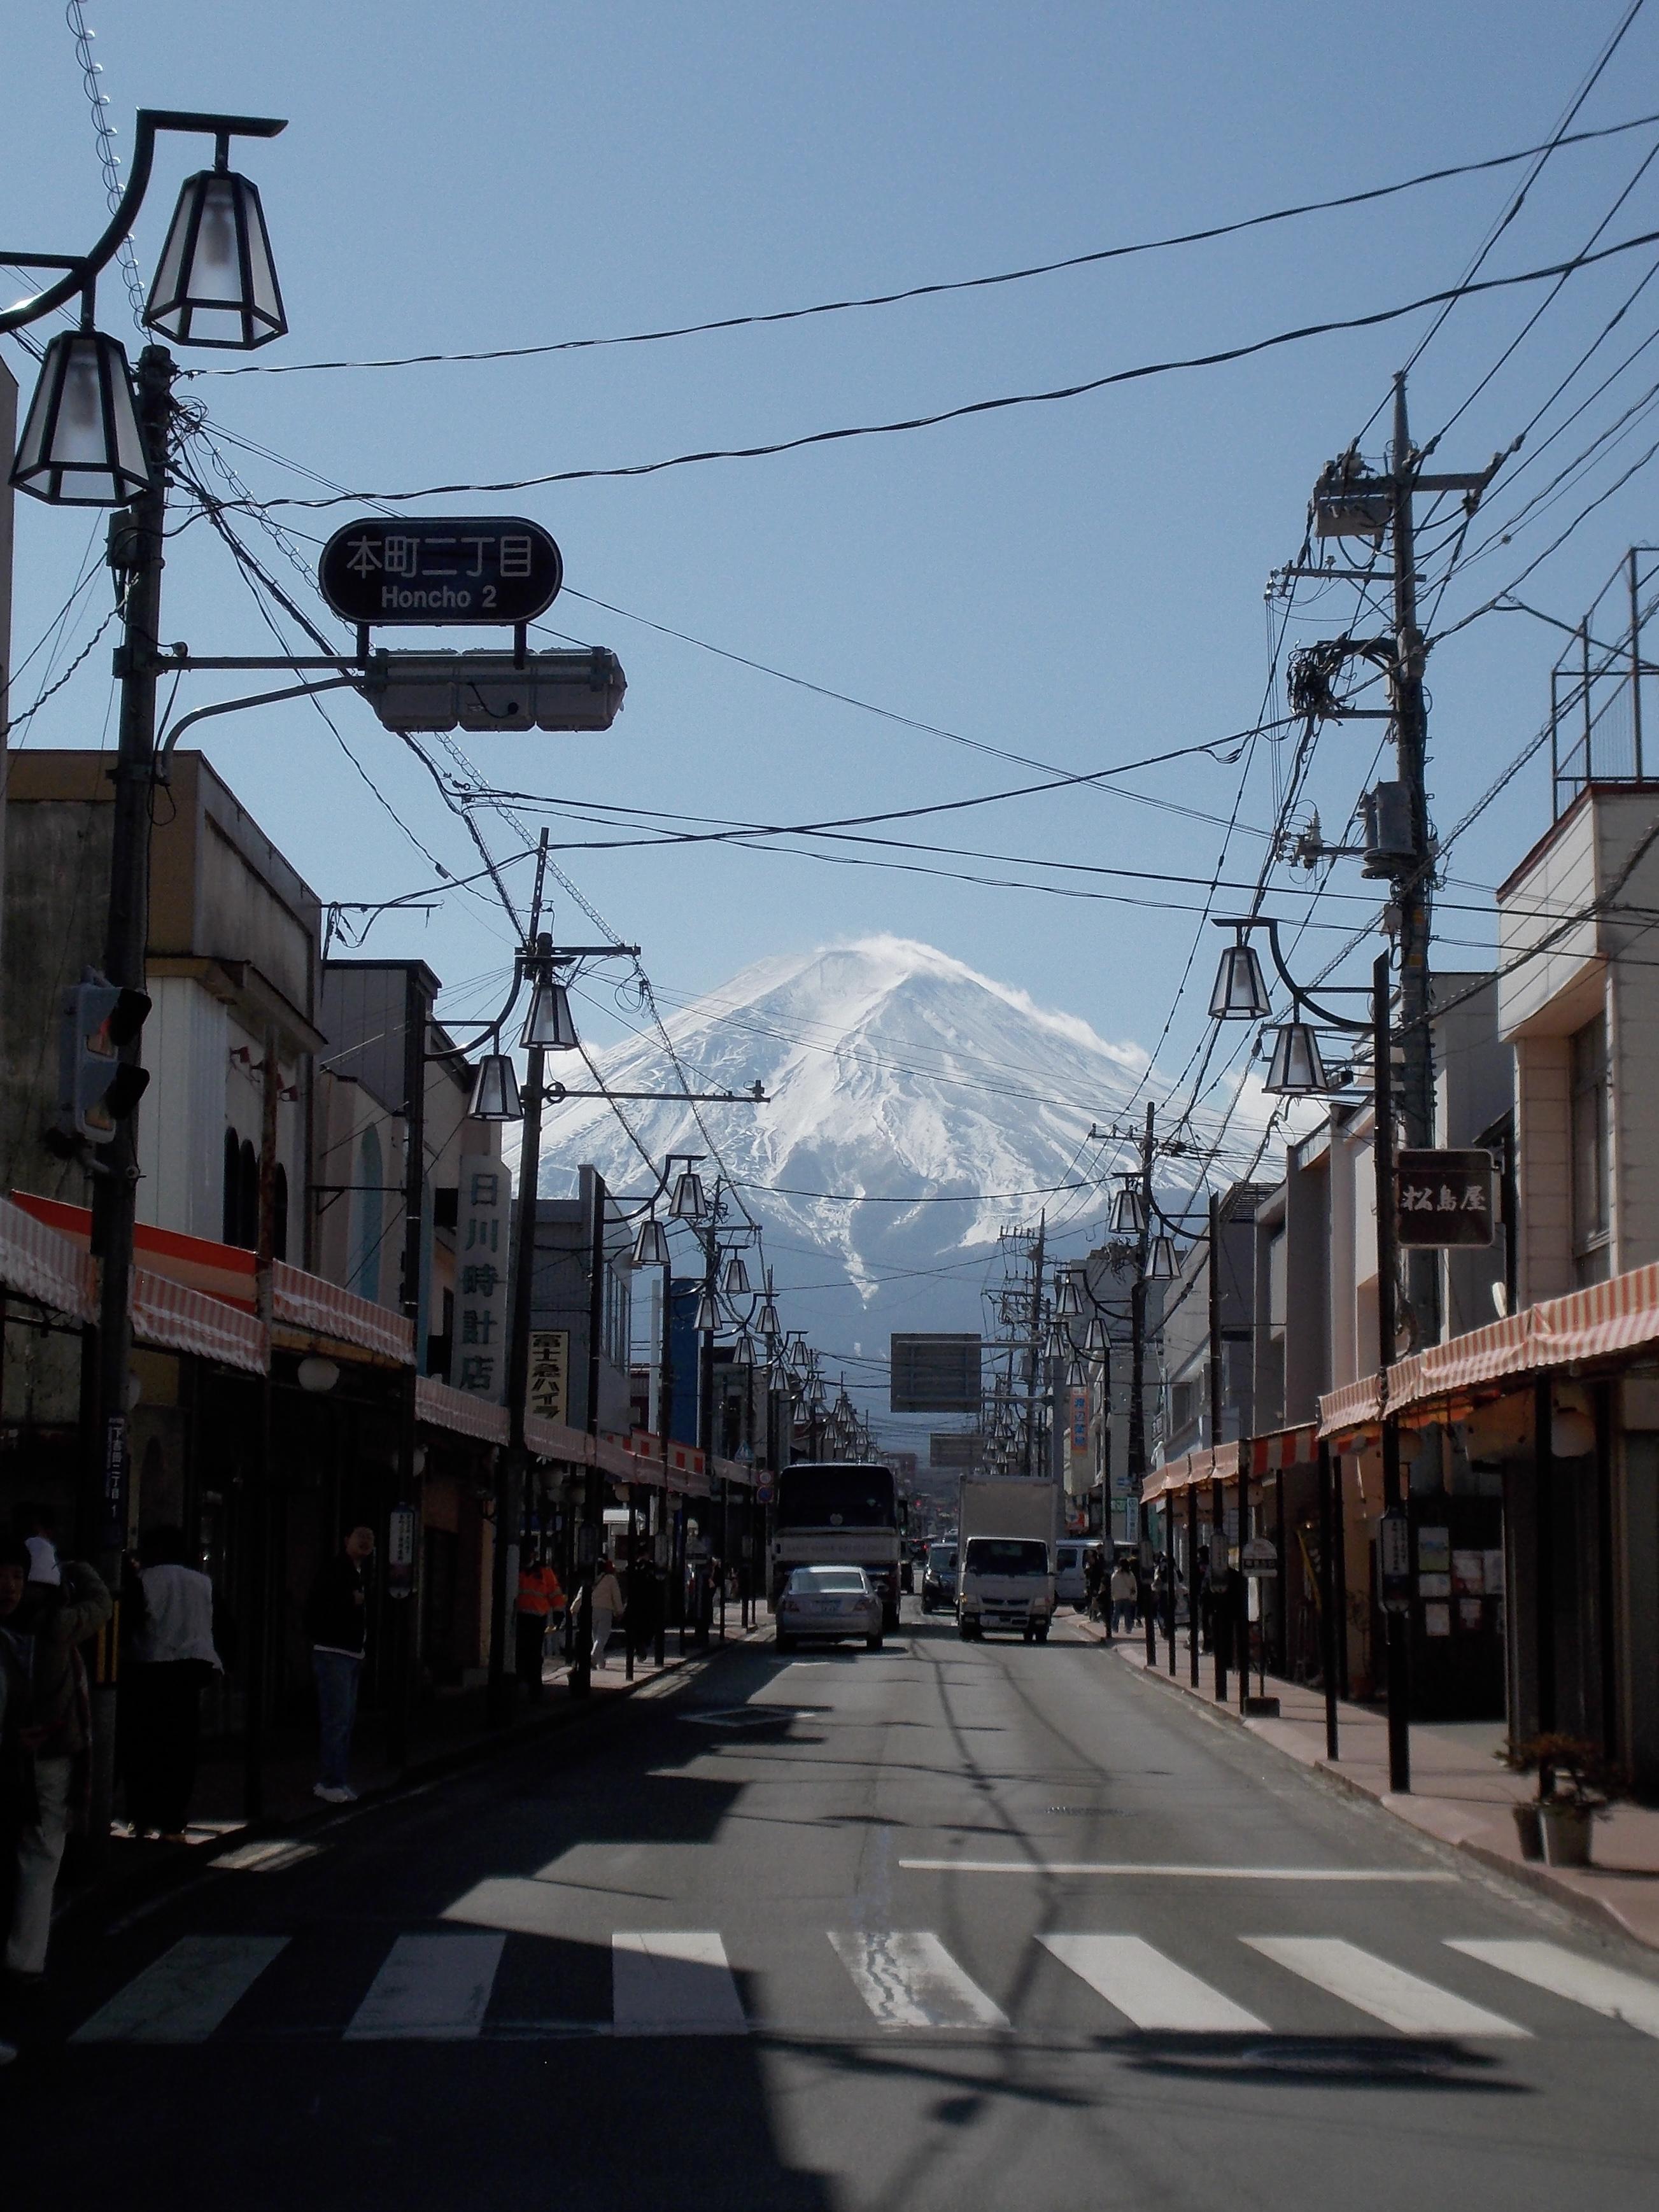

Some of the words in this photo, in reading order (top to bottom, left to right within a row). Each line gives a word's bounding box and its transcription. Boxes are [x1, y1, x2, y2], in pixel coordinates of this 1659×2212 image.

[346, 535, 532, 578] 本町二丁目
[382, 586, 471, 608] Honcho
[482, 586, 497, 607] 2
[1400, 1183, 1487, 1212] 松島屋
[461, 1173, 498, 1390] 日川時計店
